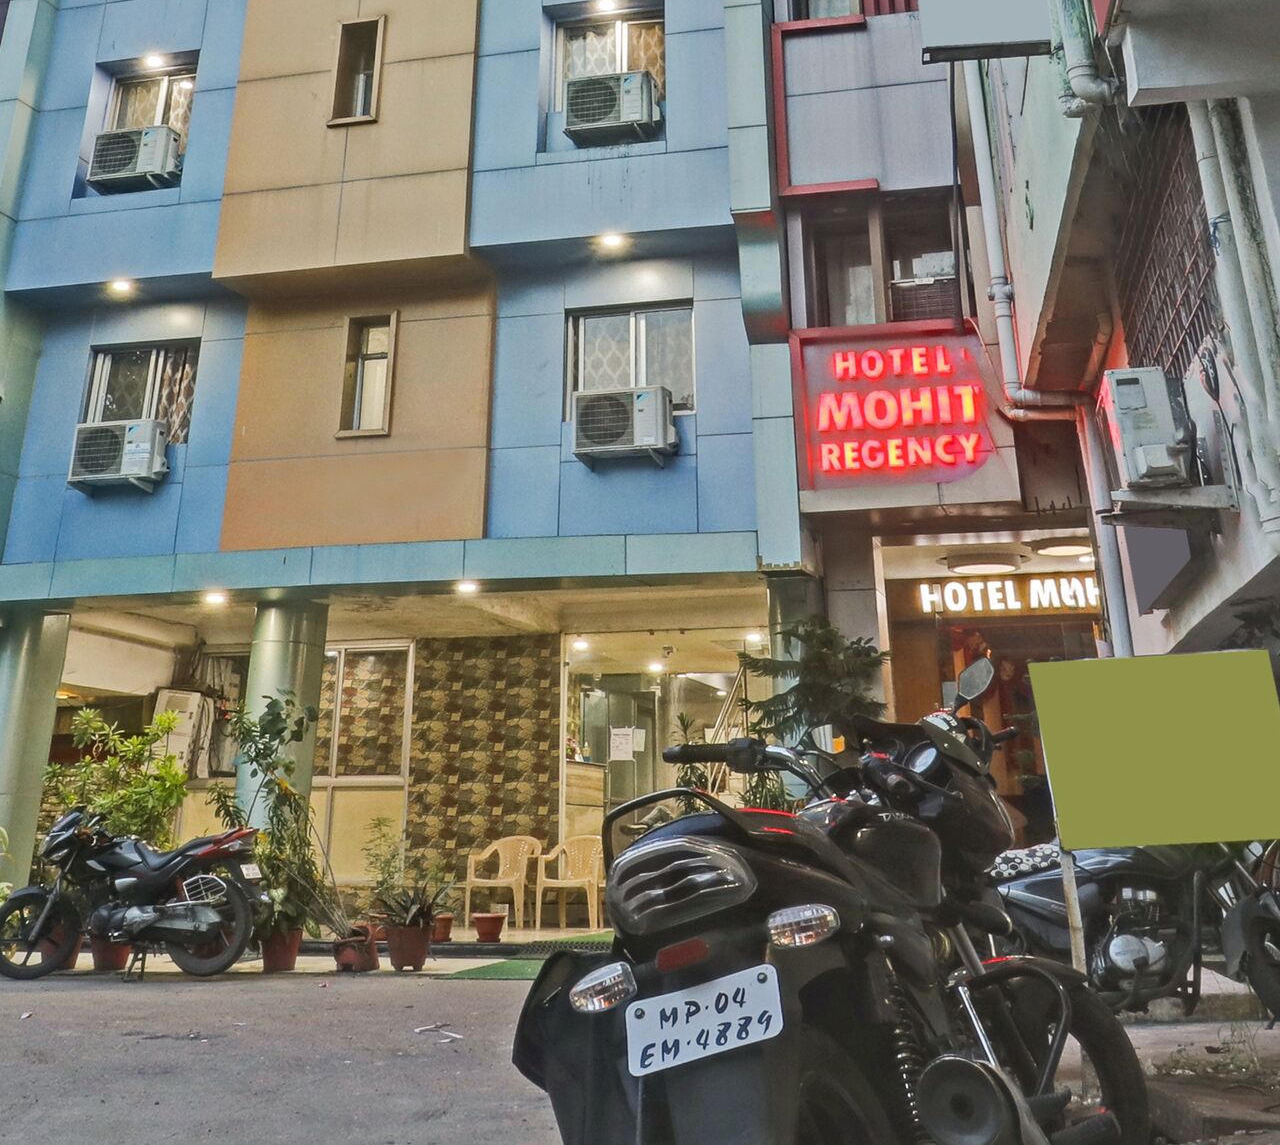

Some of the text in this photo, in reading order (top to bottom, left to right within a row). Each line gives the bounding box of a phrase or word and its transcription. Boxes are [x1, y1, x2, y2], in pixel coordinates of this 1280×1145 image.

[833, 345, 951, 380] HOTEL
[817, 384, 980, 432] MOHIT
[820, 433, 980, 471] REGENCY
[919, 580, 1022, 613] HOTEL
